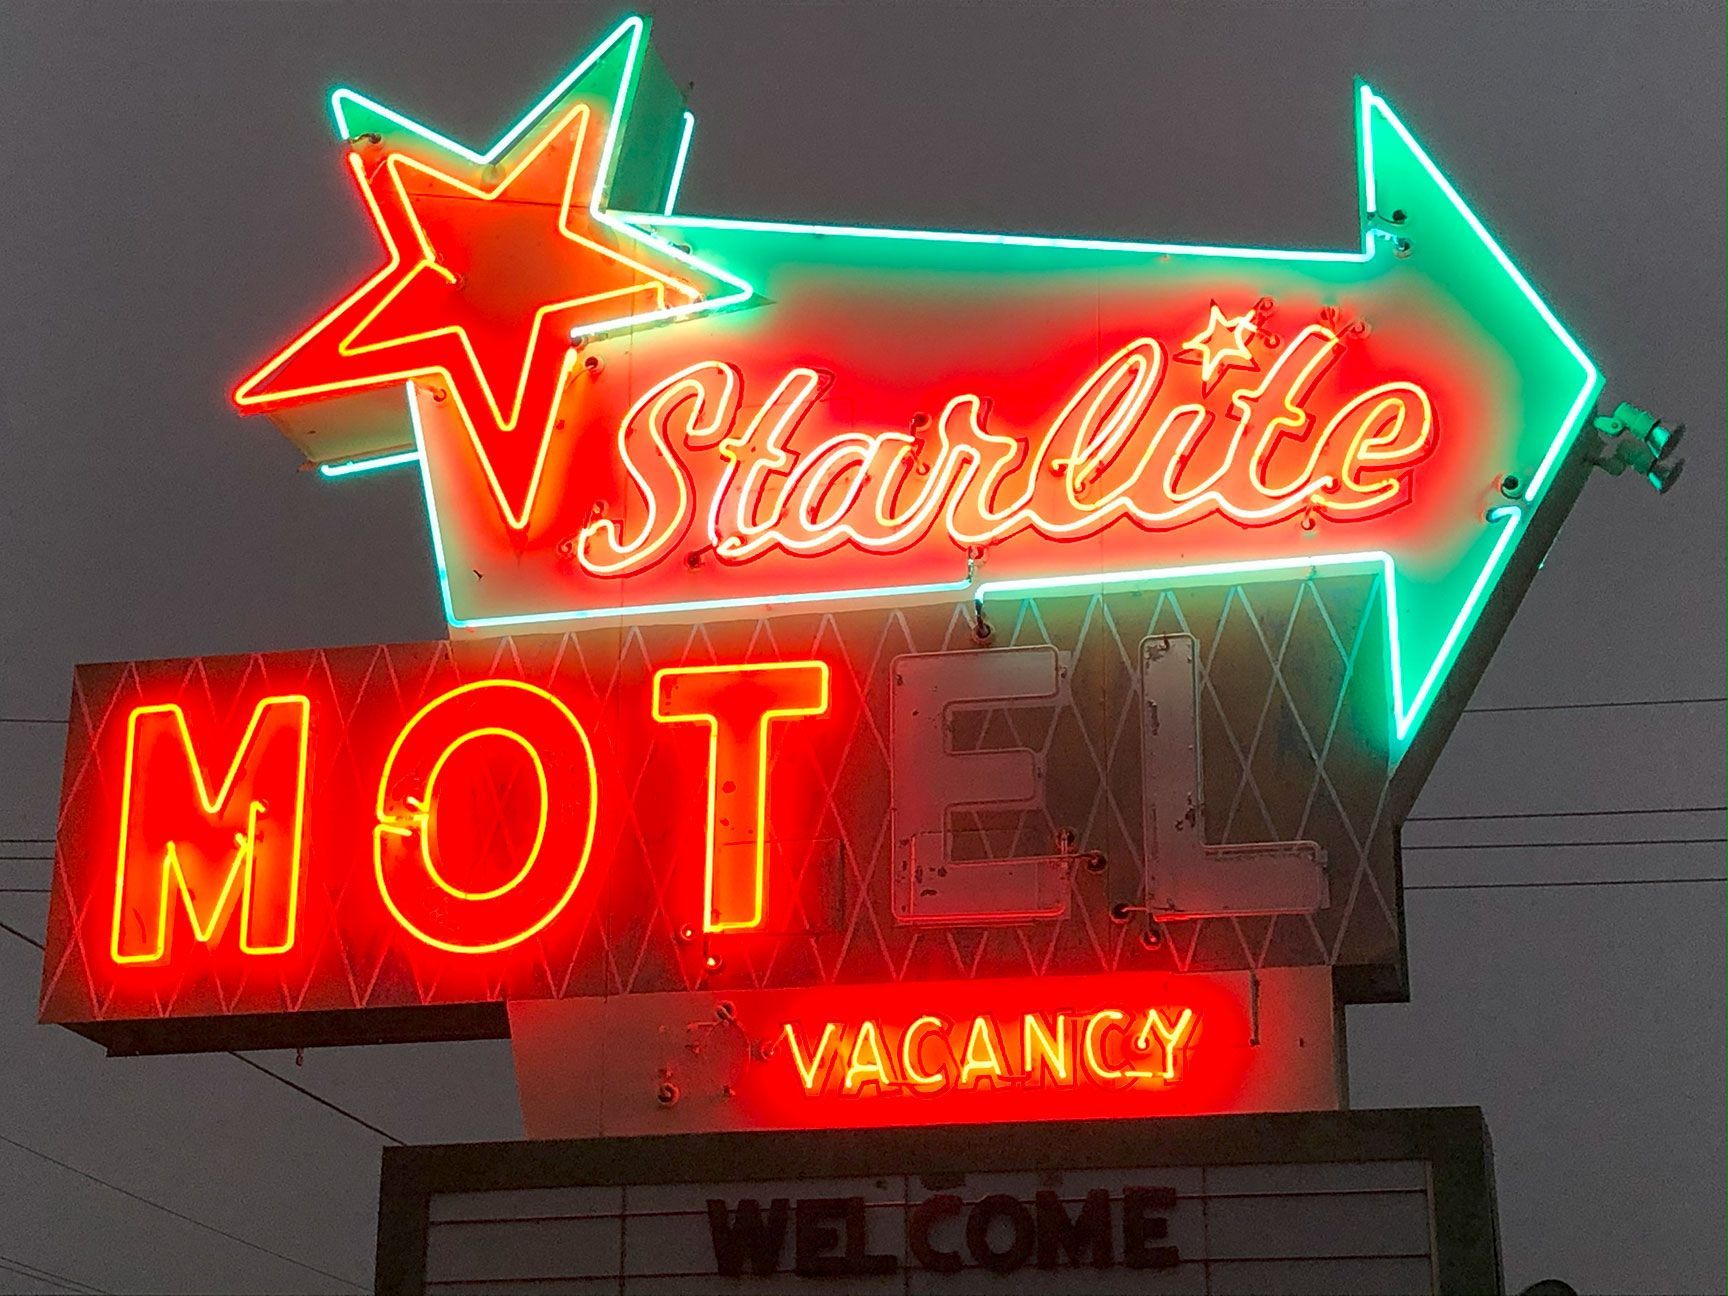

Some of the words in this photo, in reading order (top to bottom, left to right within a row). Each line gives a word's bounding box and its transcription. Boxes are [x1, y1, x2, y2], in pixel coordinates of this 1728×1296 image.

[577, 302, 1439, 578] Starlite
[111, 633, 1332, 964] MOTEL
[783, 1007, 1197, 1094] VACANCY
[706, 1186, 1181, 1277] WELCOME
